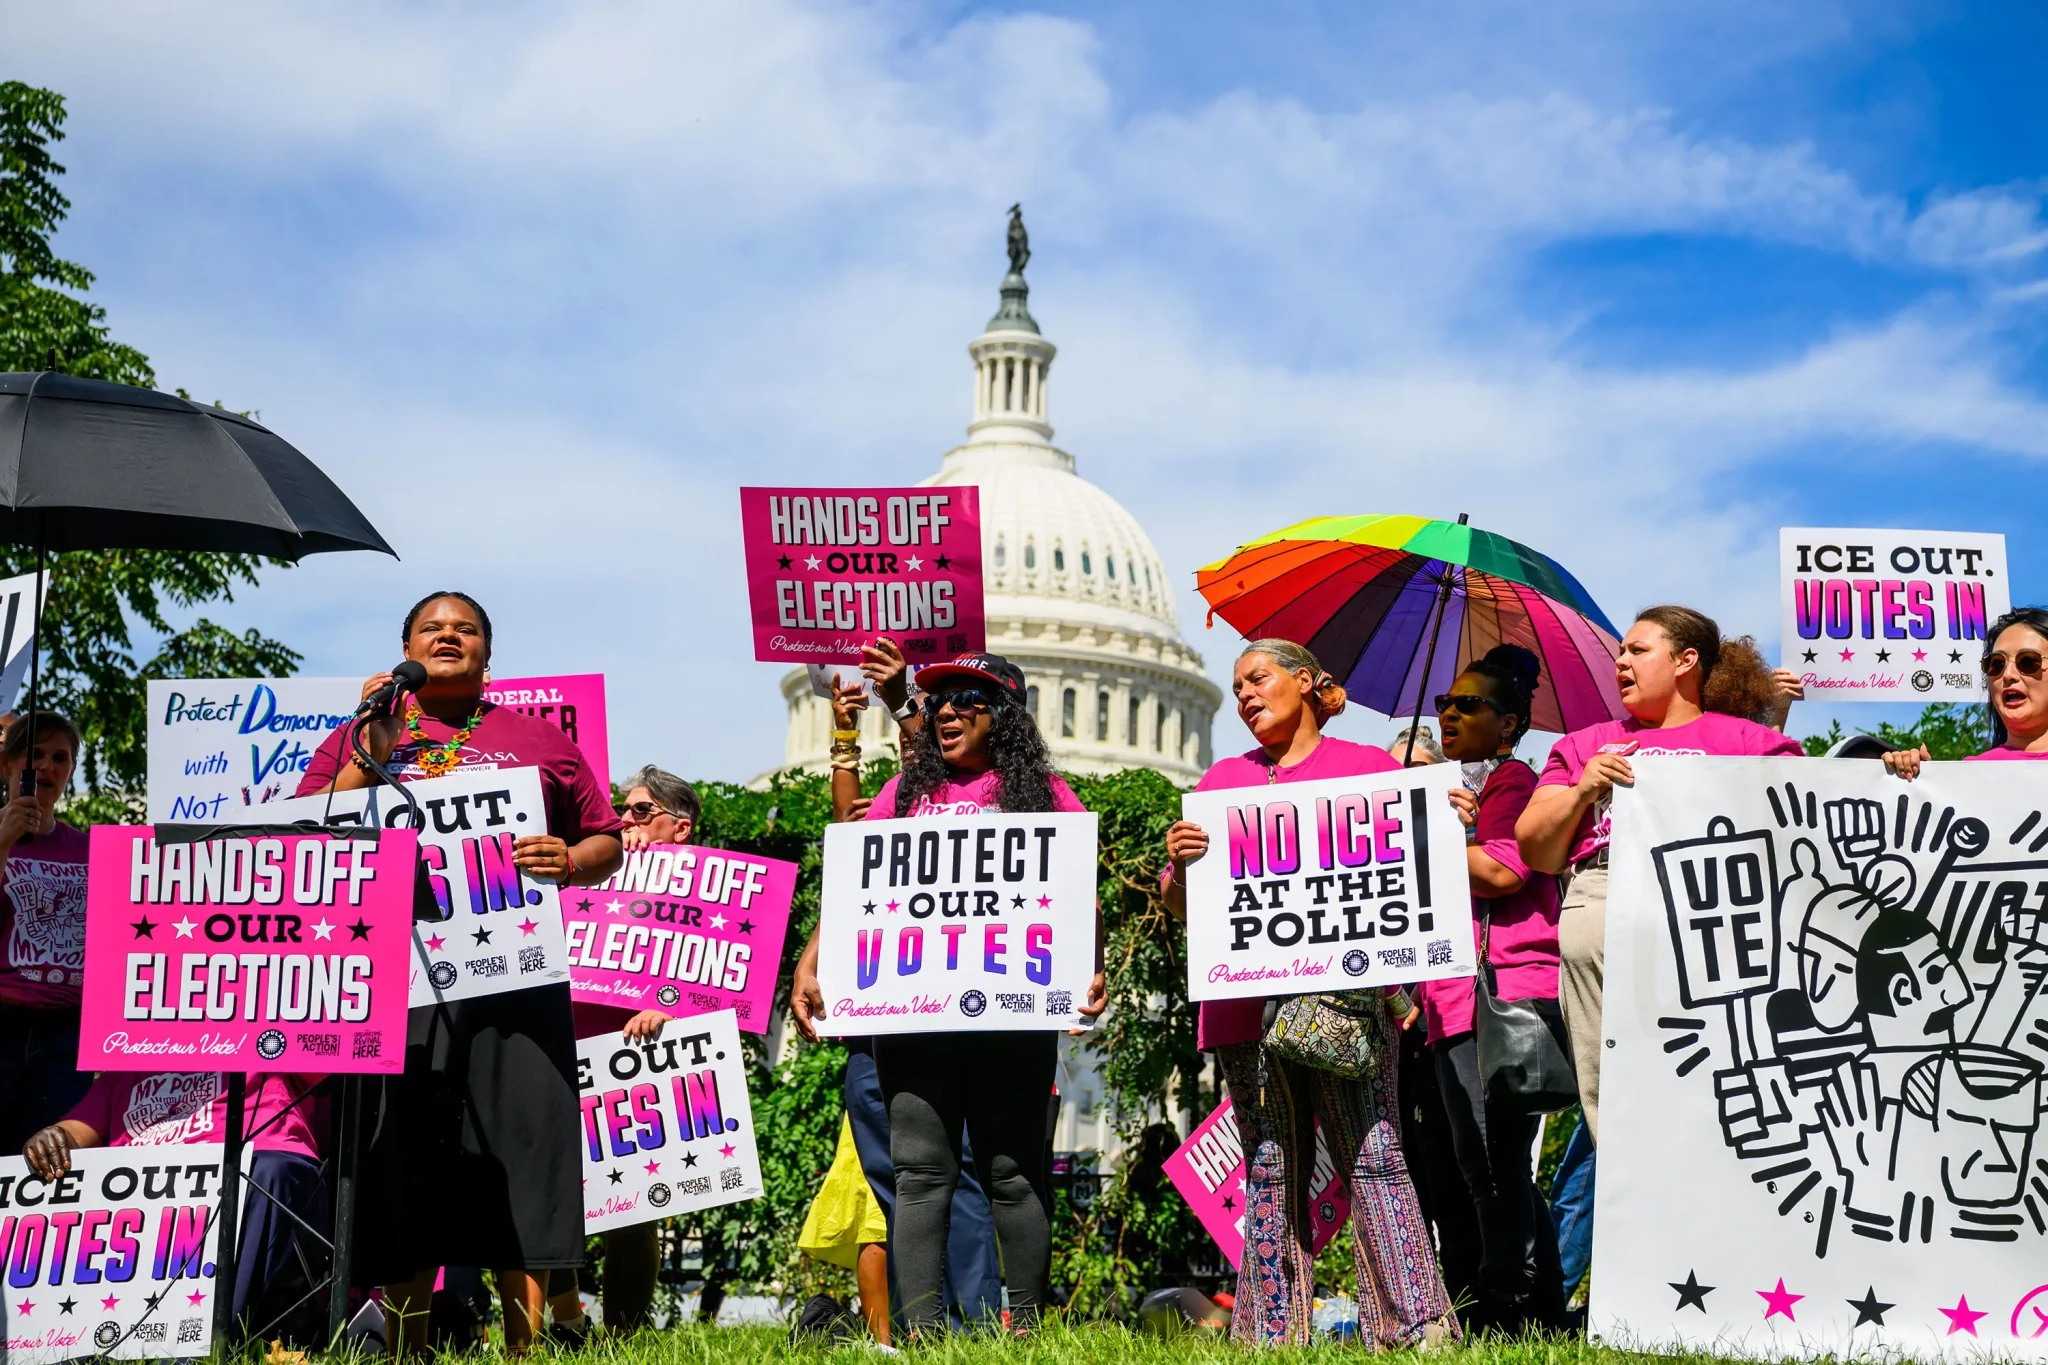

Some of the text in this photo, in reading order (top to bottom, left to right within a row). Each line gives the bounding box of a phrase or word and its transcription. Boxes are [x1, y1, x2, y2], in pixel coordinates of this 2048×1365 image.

[770, 495, 951, 546] HANDS OFF
[826, 552, 899, 574] OUR
[1796, 545, 1994, 577] ICE OUT.
[776, 580, 956, 631] ELECTIONS
[1794, 579, 1988, 640] VOTES IN
[770, 635, 814, 652] Protect
[814, 645, 834, 653] our
[952, 658, 989, 670] TURE
[1800, 672, 1847, 688] Protect
[1847, 679, 1868, 688] our
[1870, 672, 1904, 688] Vote!
[480, 688, 563, 705] DERAL
[165, 684, 351, 734] Protect Democra
[184, 751, 228, 776] with
[455, 765, 492, 773] POWER
[461, 752, 520, 765] CASA
[385, 789, 528, 836] OUT.
[1227, 800, 1301, 880] NO
[1316, 788, 1405, 870] ICE
[7, 859, 33, 878] MY
[862, 827, 1056, 889] PROTECT
[130, 838, 287, 905] HANDS
[293, 840, 377, 906] OFF
[462, 832, 543, 915] IN.
[579, 850, 767, 909] ANDS OFF
[1680, 852, 1764, 911] VO
[1229, 866, 1405, 913] AT THE
[629, 899, 703, 927] OUR
[908, 890, 1000, 919] OUR
[204, 914, 302, 943] OUR
[13, 927, 46, 963] MY
[1378, 948, 1413, 959] PEOPLE'S
[1427, 944, 1452, 955] REVIVAL
[1689, 911, 1768, 983] TE
[465, 955, 504, 970] PEOPLE'S
[519, 952, 545, 963] REVIVAL
[520, 957, 547, 975] HERE
[566, 921, 752, 992] ELECTIONS
[857, 923, 1053, 991] VOTES
[1383, 956, 1414, 966] ACTION
[1428, 951, 1453, 967] HERE
[472, 964, 505, 976] ACTION
[1208, 956, 1333, 983] Protect our Vote!
[124, 953, 373, 1023] ELECTIONS
[570, 978, 651, 998] tect our Vote!
[688, 991, 719, 1003] PEOPLE'S
[961, 990, 985, 1002] POPULAR
[995, 993, 1032, 1001] PEOPLE'S
[691, 999, 718, 1010] ACTION
[736, 1010, 751, 1020] ERE
[833, 994, 952, 1017] Protect our Vote!
[1000, 1001, 1032, 1009] ACTION
[1046, 1003, 1072, 1016] HERE
[103, 1031, 248, 1054] Protect our Vote!
[258, 1030, 285, 1044] POPULAR
[297, 1034, 338, 1043] PEOPLE'S
[302, 1043, 338, 1051] ACTION
[354, 1036, 382, 1045] REVIVAL
[257, 1047, 284, 1059] DEMOCRACY
[353, 1045, 381, 1059] HERE
[609, 1032, 726, 1081] OUT.
[134, 1077, 167, 1106] MY
[169, 1072, 214, 1094] POW
[580, 1082, 666, 1163] TES
[671, 1069, 740, 1142] IN.
[1185, 1106, 1244, 1194] HAN
[0, 1164, 222, 1208] ICE OUT.
[677, 1177, 708, 1189] PEOPLE'S
[683, 1184, 709, 1195] ACTION
[722, 1177, 745, 1192] HERE
[586, 1191, 639, 1219] our Vote!
[152, 1205, 217, 1280] IN.
[20, 1337, 44, 1349] our
[47, 1326, 87, 1347] Vote!
[134, 1331, 164, 1339] ACTION
[177, 1330, 202, 1344] HERE
